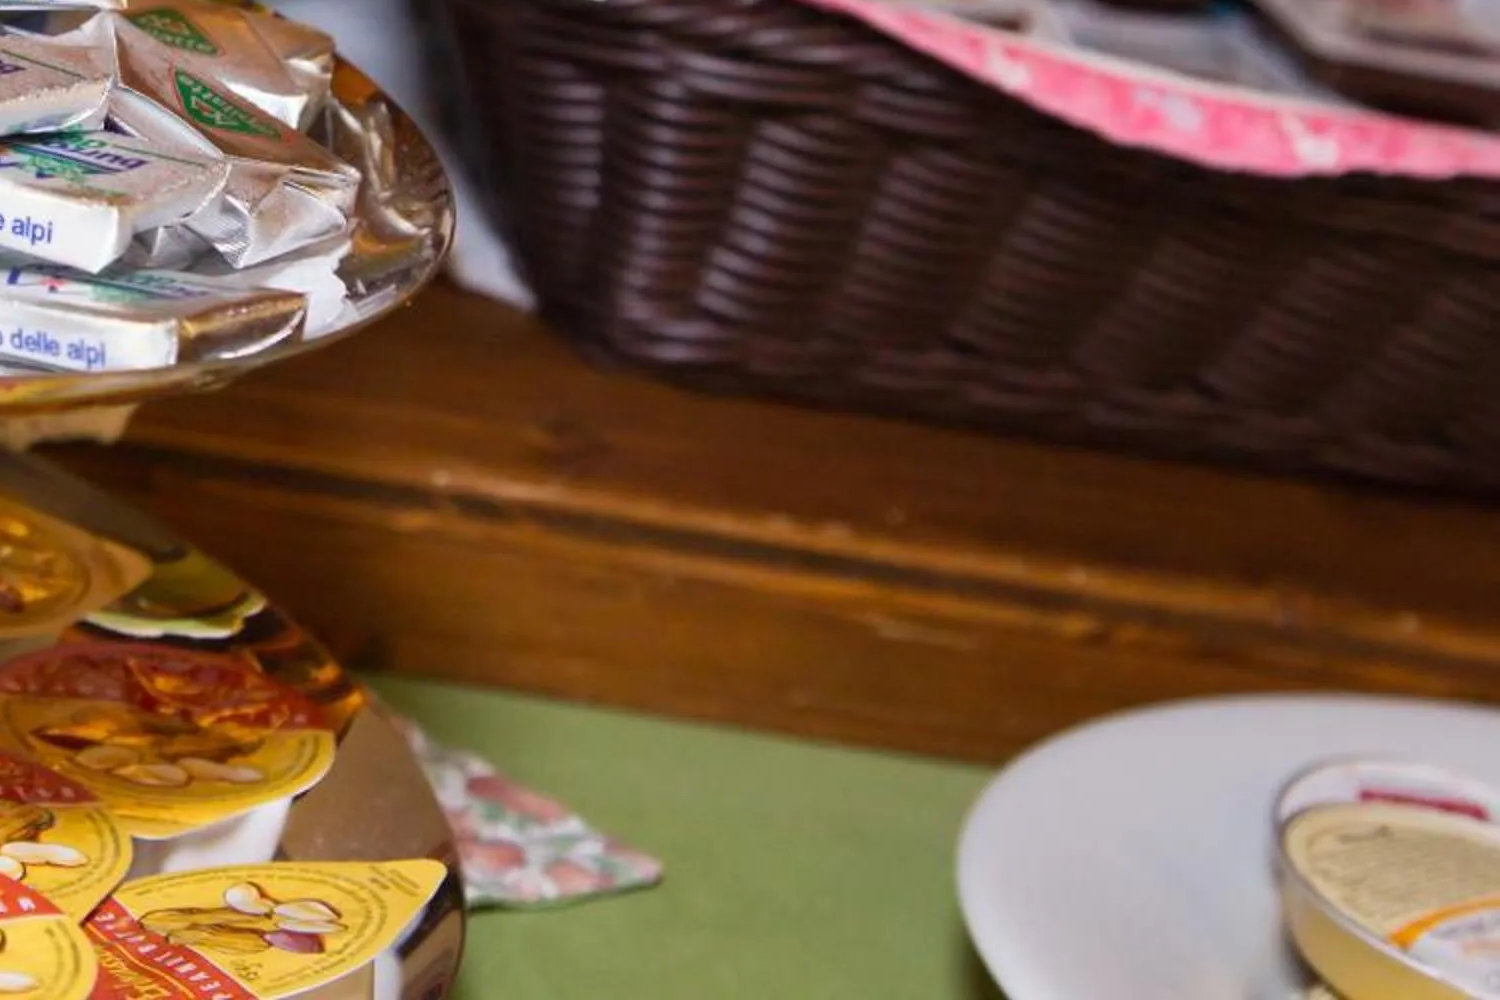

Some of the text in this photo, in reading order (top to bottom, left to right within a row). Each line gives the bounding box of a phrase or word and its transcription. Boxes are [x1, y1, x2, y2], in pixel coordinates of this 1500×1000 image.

[11, 216, 53, 245] alpi
[10, 329, 61, 358] delle
[67, 340, 107, 369] alpi
